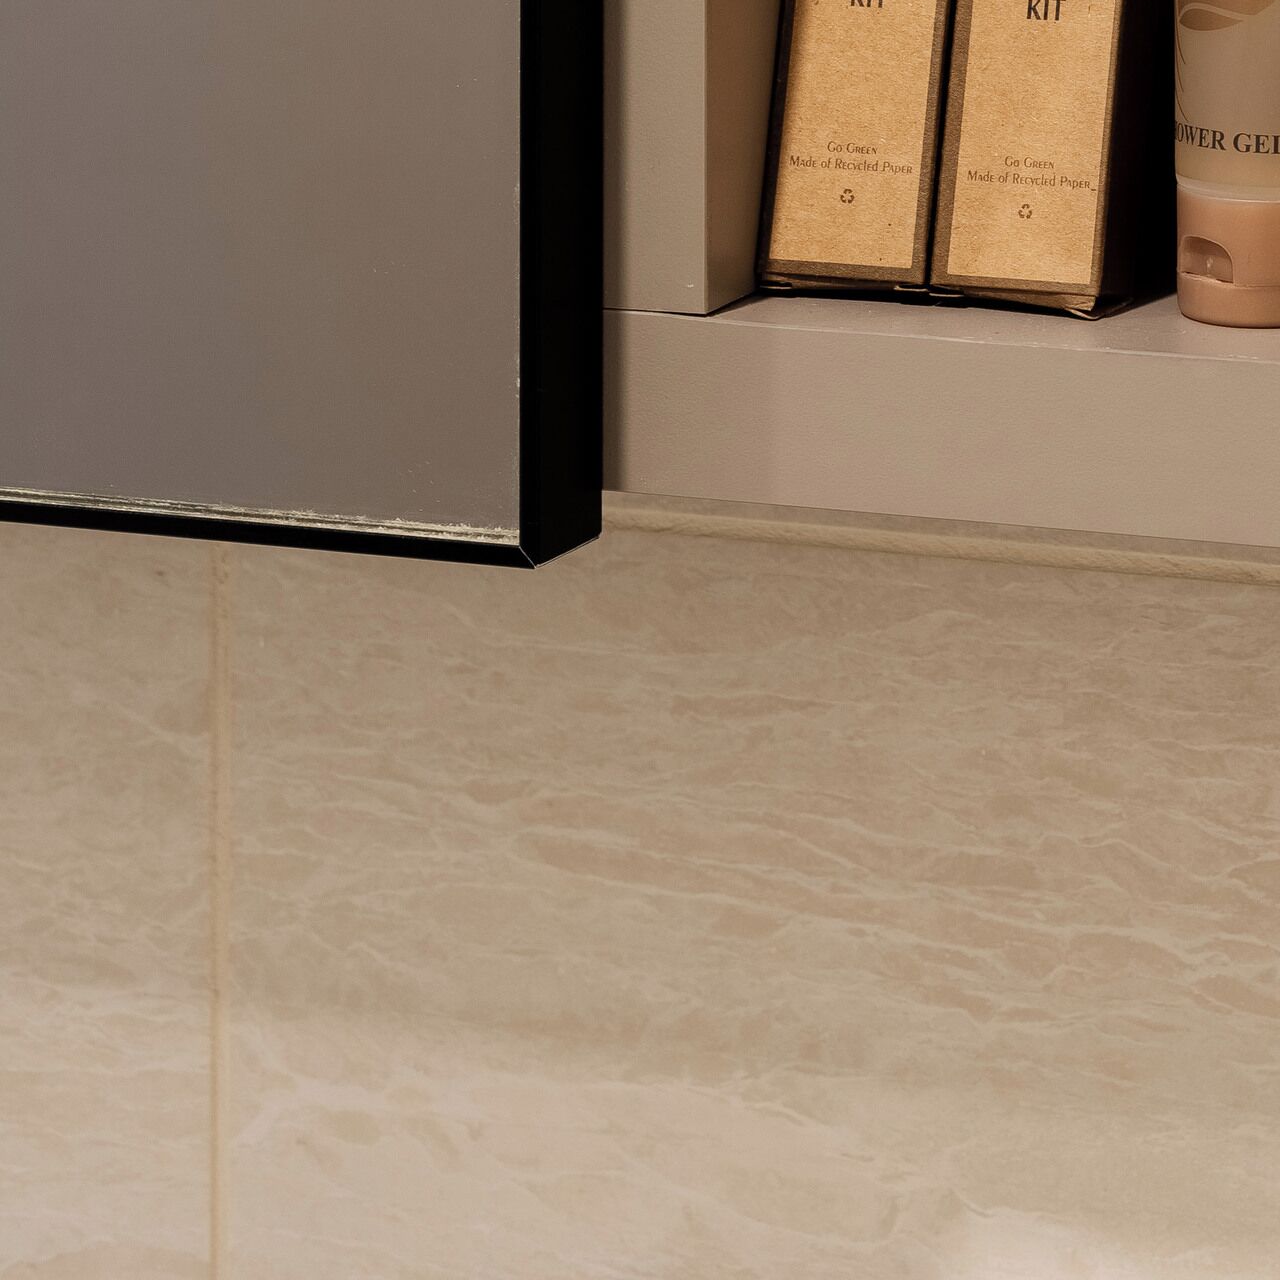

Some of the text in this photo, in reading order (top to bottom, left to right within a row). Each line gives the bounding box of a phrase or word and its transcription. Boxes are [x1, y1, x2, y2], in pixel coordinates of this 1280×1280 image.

[827, 141, 843, 154] Go
[820, 157, 831, 170] of
[1004, 155, 1020, 168] Go
[998, 171, 1010, 185] of
